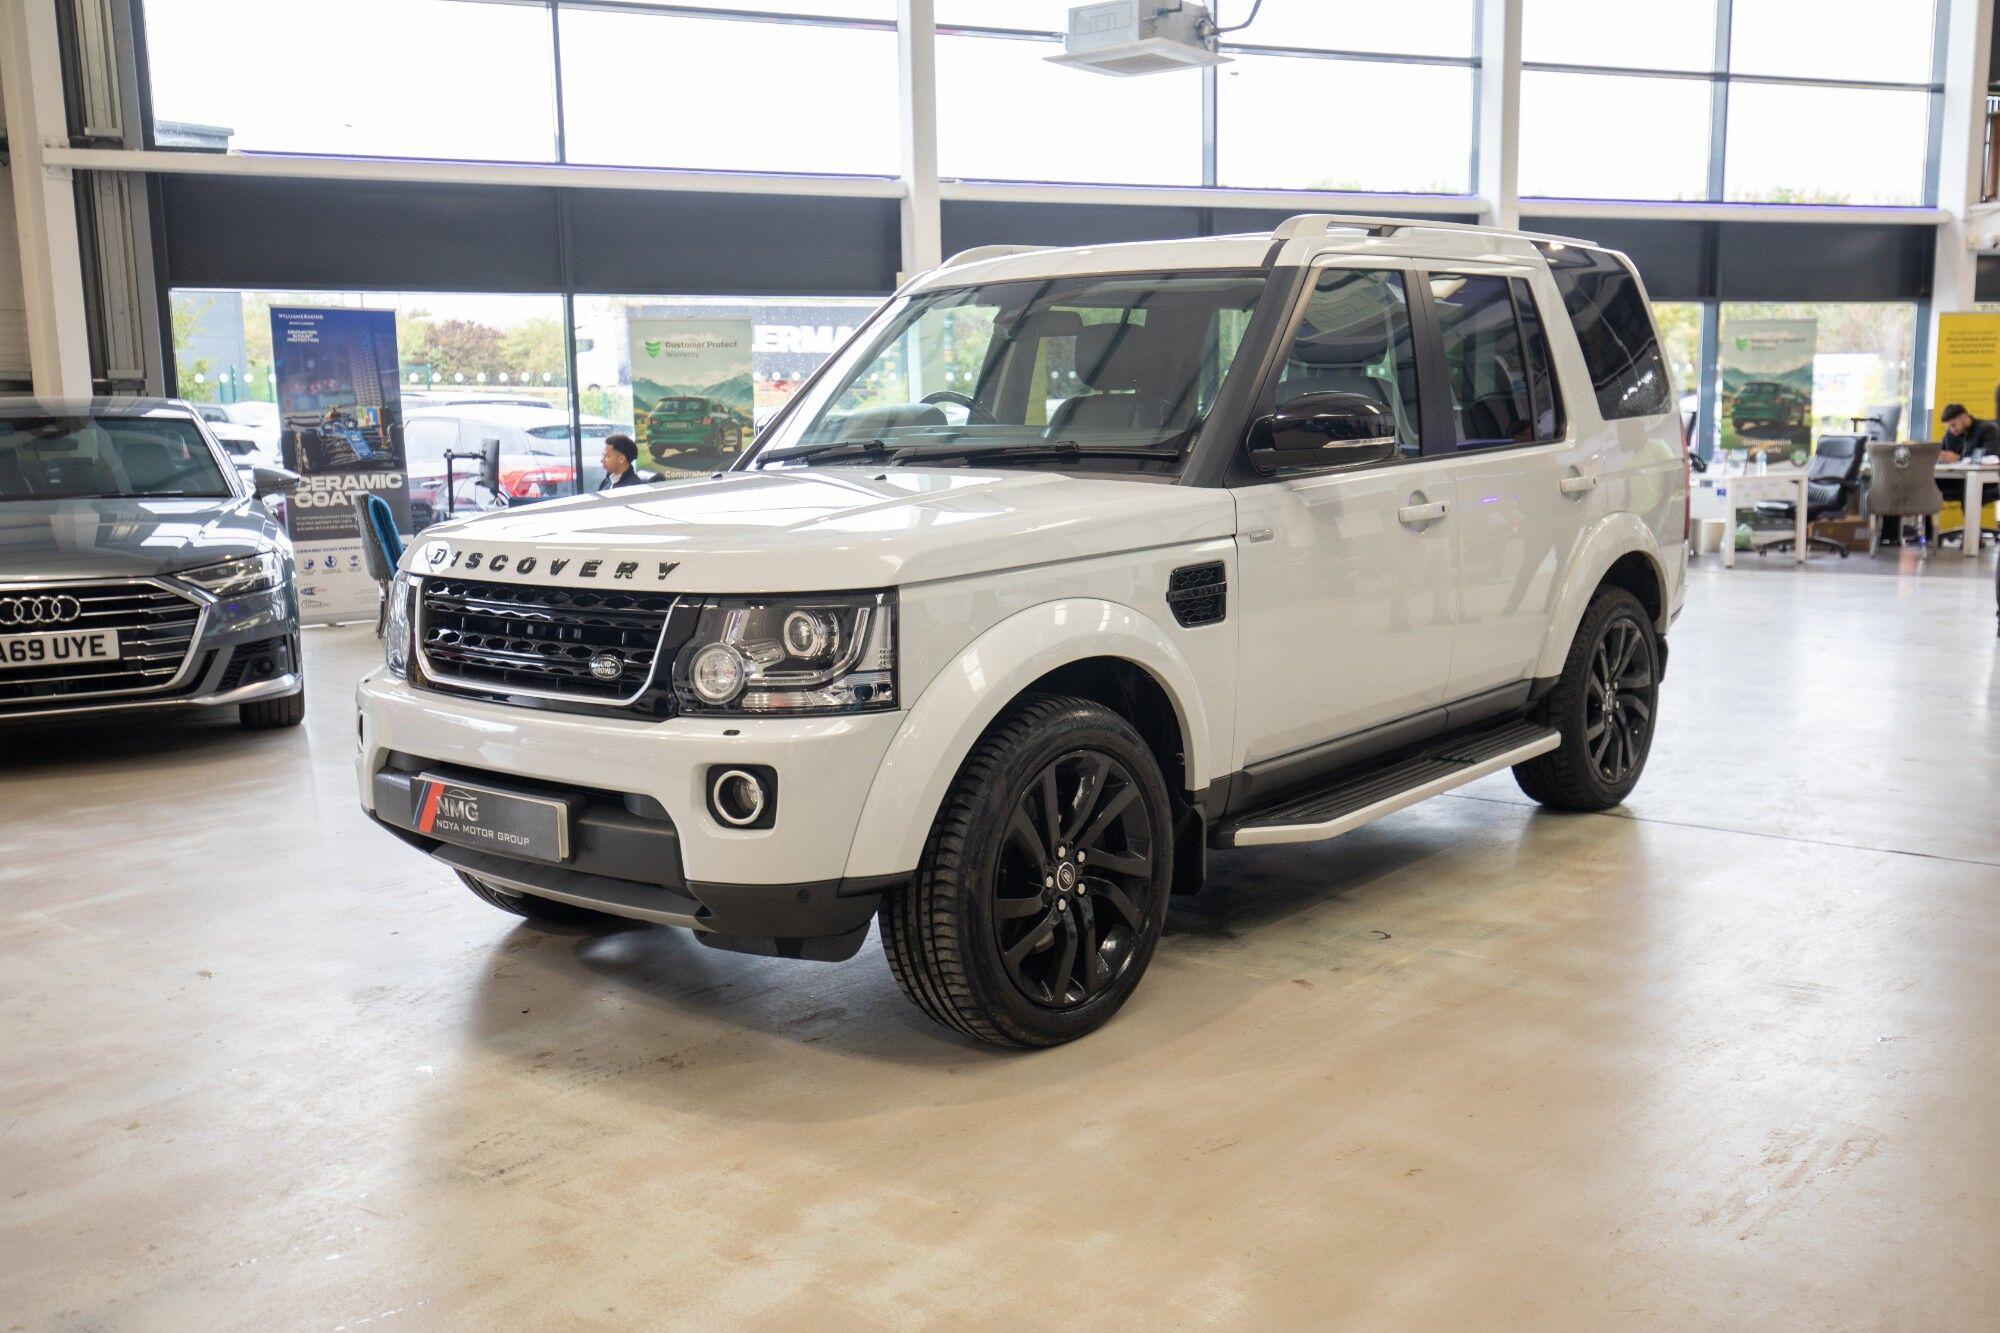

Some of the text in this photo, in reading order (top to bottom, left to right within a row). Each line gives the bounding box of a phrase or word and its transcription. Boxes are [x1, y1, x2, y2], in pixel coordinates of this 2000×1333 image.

[665, 340, 738, 349] Customer Protect
[296, 472, 403, 491] CERAMIC
[294, 490, 358, 508] COAT
[430, 548, 680, 580] DISCOVERY
[52, 634, 107, 659] UYE
[436, 795, 479, 822] NMG
[436, 819, 530, 846] NOYA MOTOR GROUP
